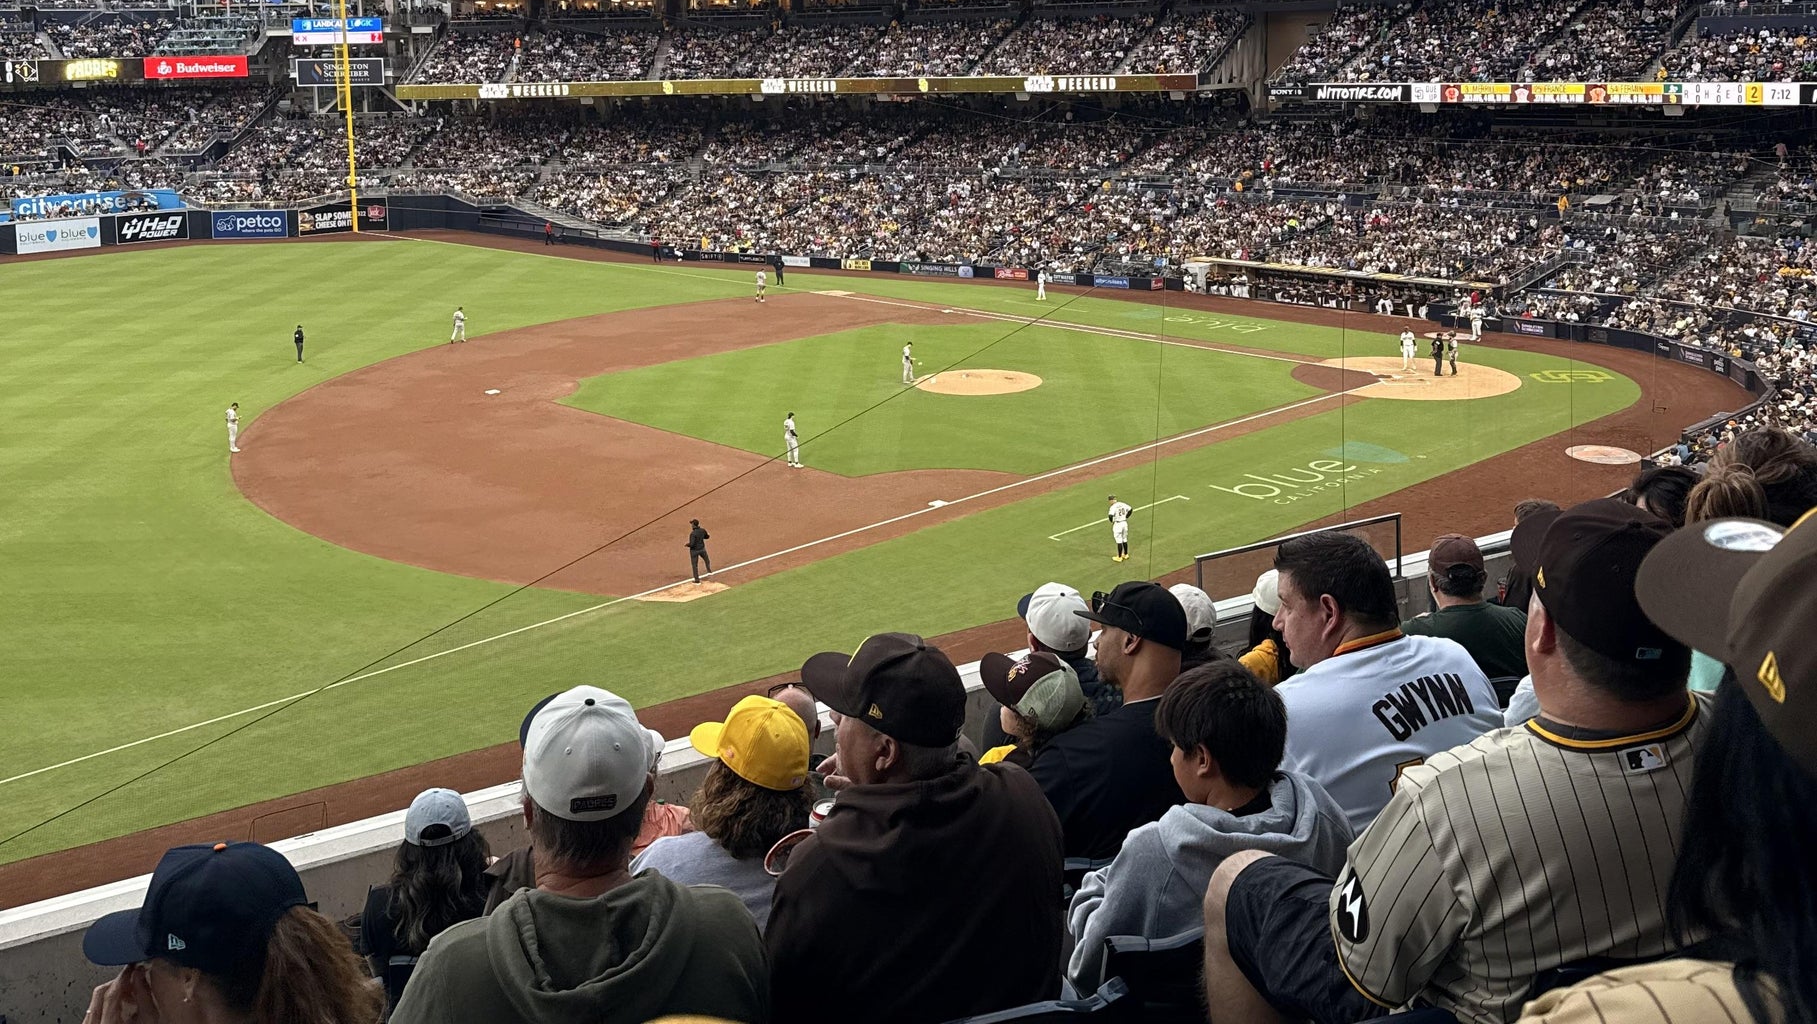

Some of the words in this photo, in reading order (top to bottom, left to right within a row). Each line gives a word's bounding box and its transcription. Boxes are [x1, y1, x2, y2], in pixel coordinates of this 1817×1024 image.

[66, 61, 119, 80] PADRES
[176, 62, 237, 74] Budweiser
[788, 80, 836, 92] WEEKEND
[1058, 78, 1116, 90] WEEKEND
[1425, 85, 1437, 93] DUE
[513, 85, 569, 96] WEEKEND
[1317, 85, 1402, 101] NITTOTIRE.COM
[1751, 86, 1758, 99] 2
[1771, 89, 1791, 99] 7:12
[1429, 93, 1438, 101] UP
[315, 212, 332, 222] SLAP
[333, 211, 352, 220] SOME
[141, 216, 183, 231] H2O
[237, 215, 281, 231] petco
[316, 220, 337, 229] CHEESE
[19, 233, 46, 243] blue
[61, 228, 87, 239] blue
[138, 229, 178, 239] POWER
[1209, 460, 1357, 500] blue
[1274, 467, 1384, 505] CALIFORNIA
[1372, 673, 1475, 742] GWYNN
